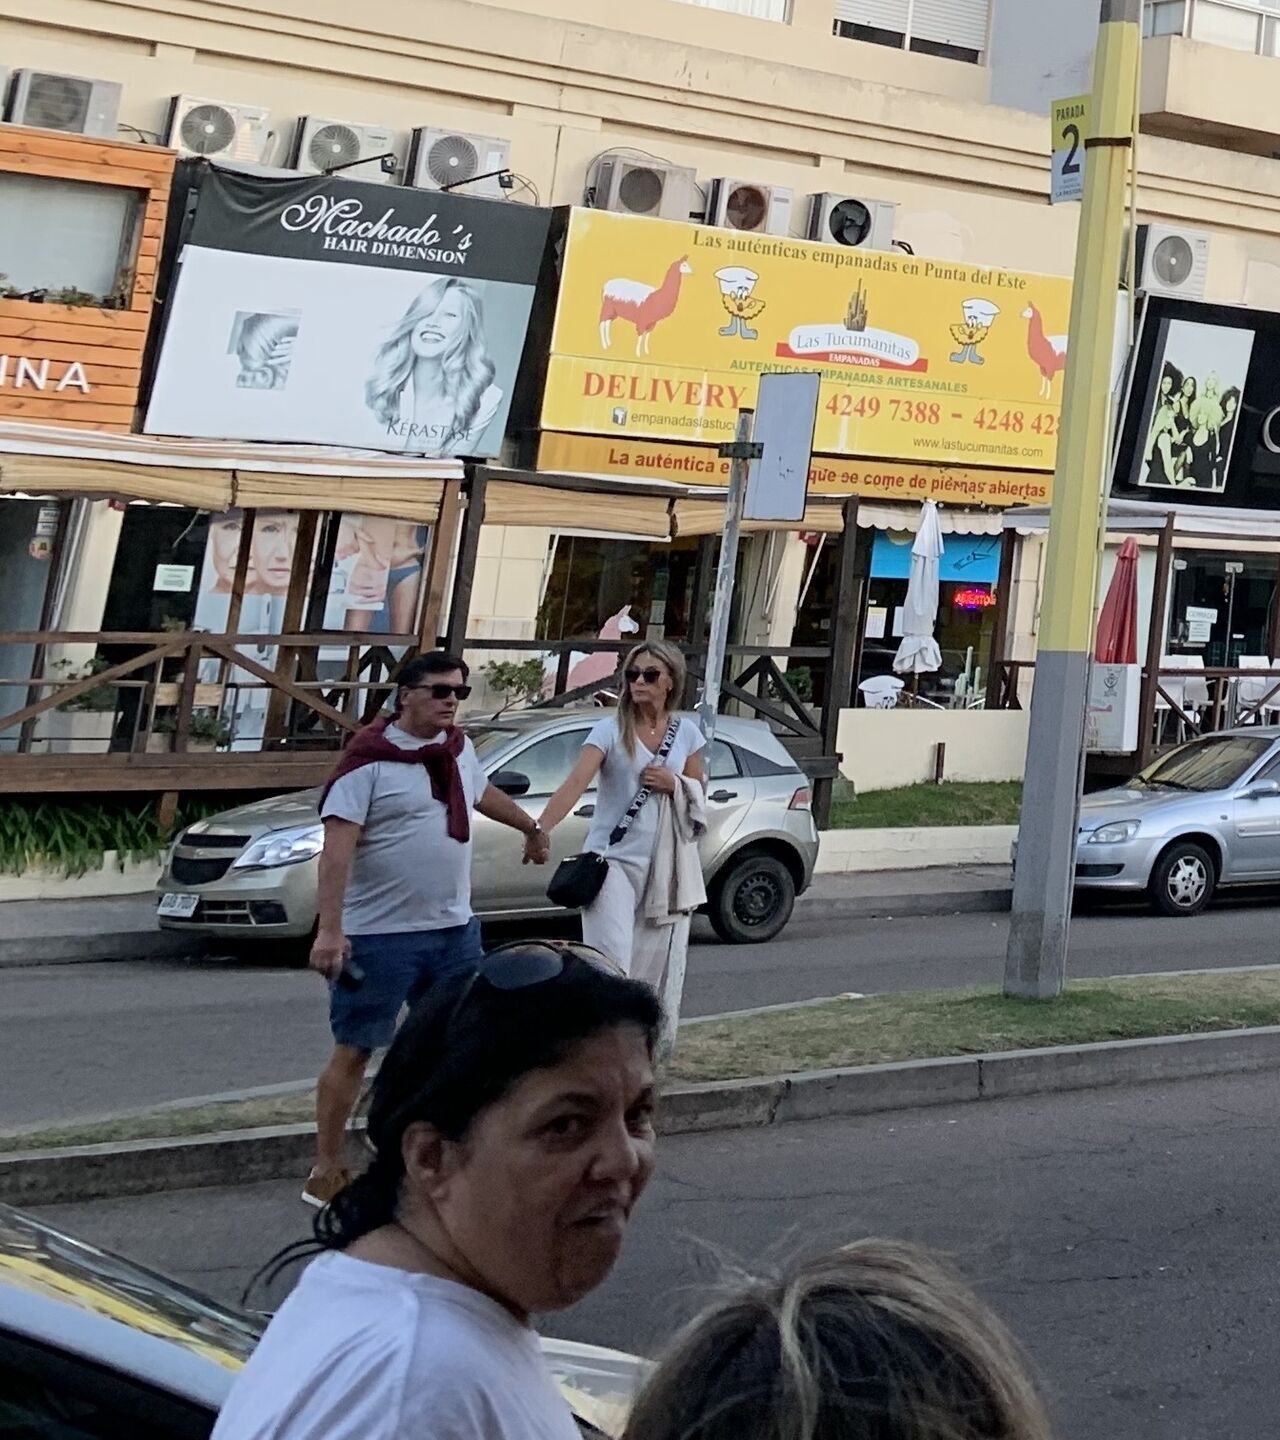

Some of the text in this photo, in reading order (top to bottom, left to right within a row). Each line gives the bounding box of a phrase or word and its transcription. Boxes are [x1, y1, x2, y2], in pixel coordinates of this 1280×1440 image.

[1056, 104, 1085, 121] PARADA
[1061, 123, 1080, 175] 2
[323, 236, 468, 265] HAIR DIMENSION
[693, 230, 1027, 290] Las auténticas empanadas en Punta del Este
[796, 331, 912, 361] Las Tucumanitas
[828, 353, 881, 367] EMPANADAS
[582, 371, 748, 409] DELIVERY
[886, 375, 969, 394] ARTESANALES
[824, 392, 881, 418] 4249
[888, 398, 941, 426] 7388
[972, 407, 1025, 434] 4248
[608, 448, 630, 466] La
[635, 452, 716, 474] auténtica
[912, 436, 1044, 459] www.lastucumanitas.com
[808, 468, 836, 486] que
[864, 473, 905, 490] come
[909, 473, 927, 489] de
[931, 476, 986, 494] piernas
[989, 480, 1047, 498] abiertas
